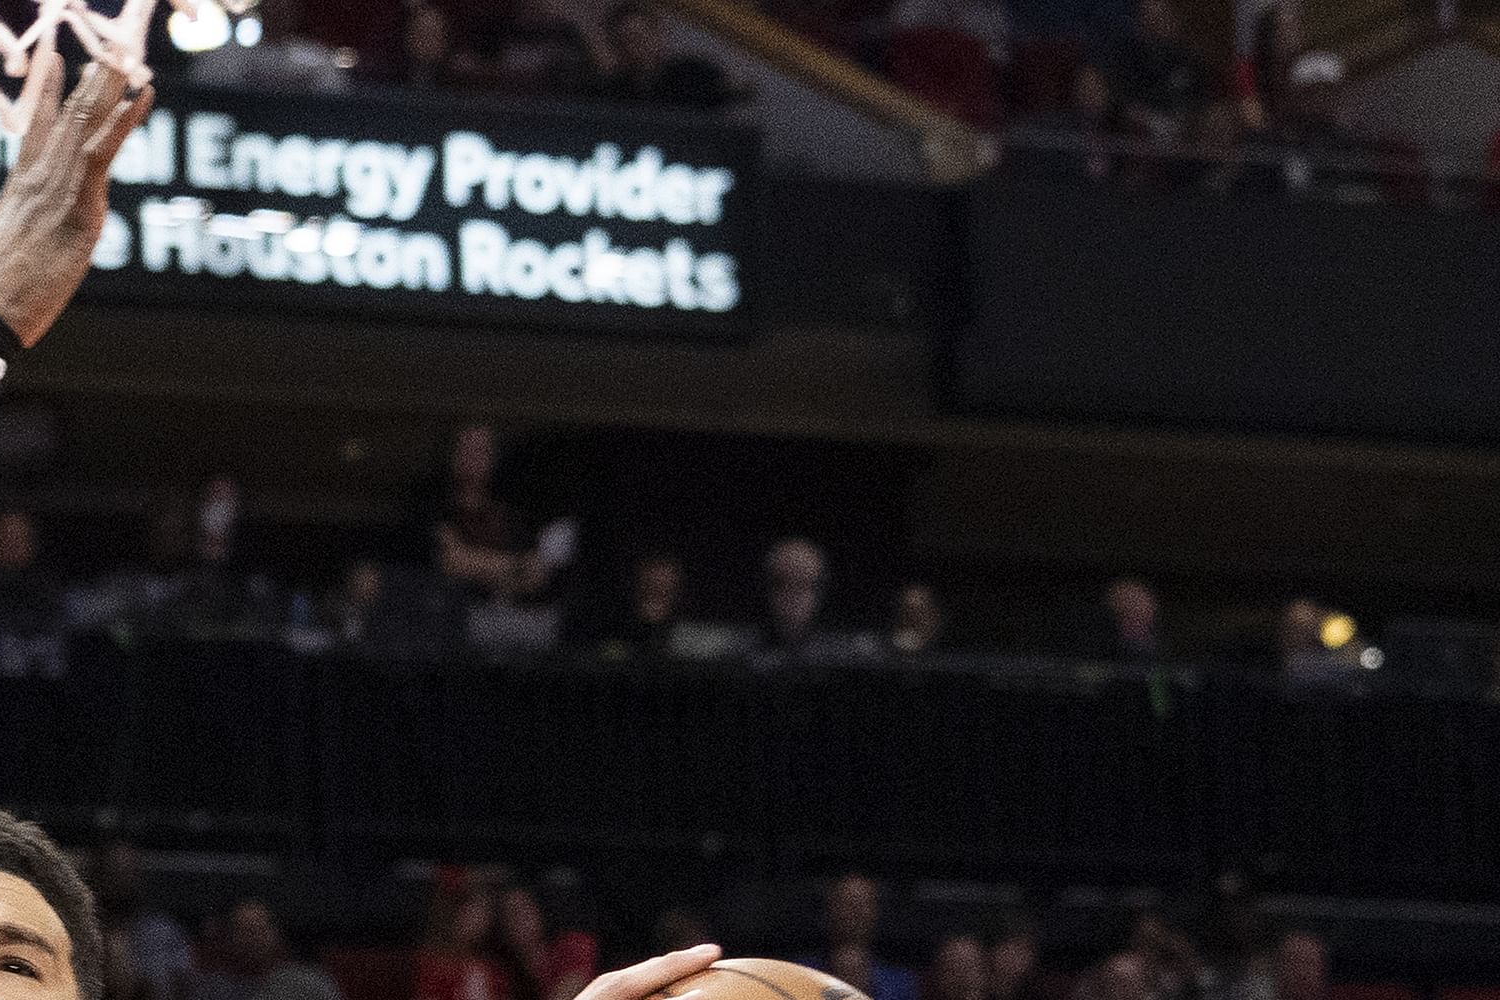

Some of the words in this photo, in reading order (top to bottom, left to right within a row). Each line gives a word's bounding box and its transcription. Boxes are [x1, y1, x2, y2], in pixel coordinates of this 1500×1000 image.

[185, 112, 435, 221] Energy
[442, 131, 734, 226] Provider
[139, 195, 450, 292] Houston
[458, 218, 740, 312] Rockets
